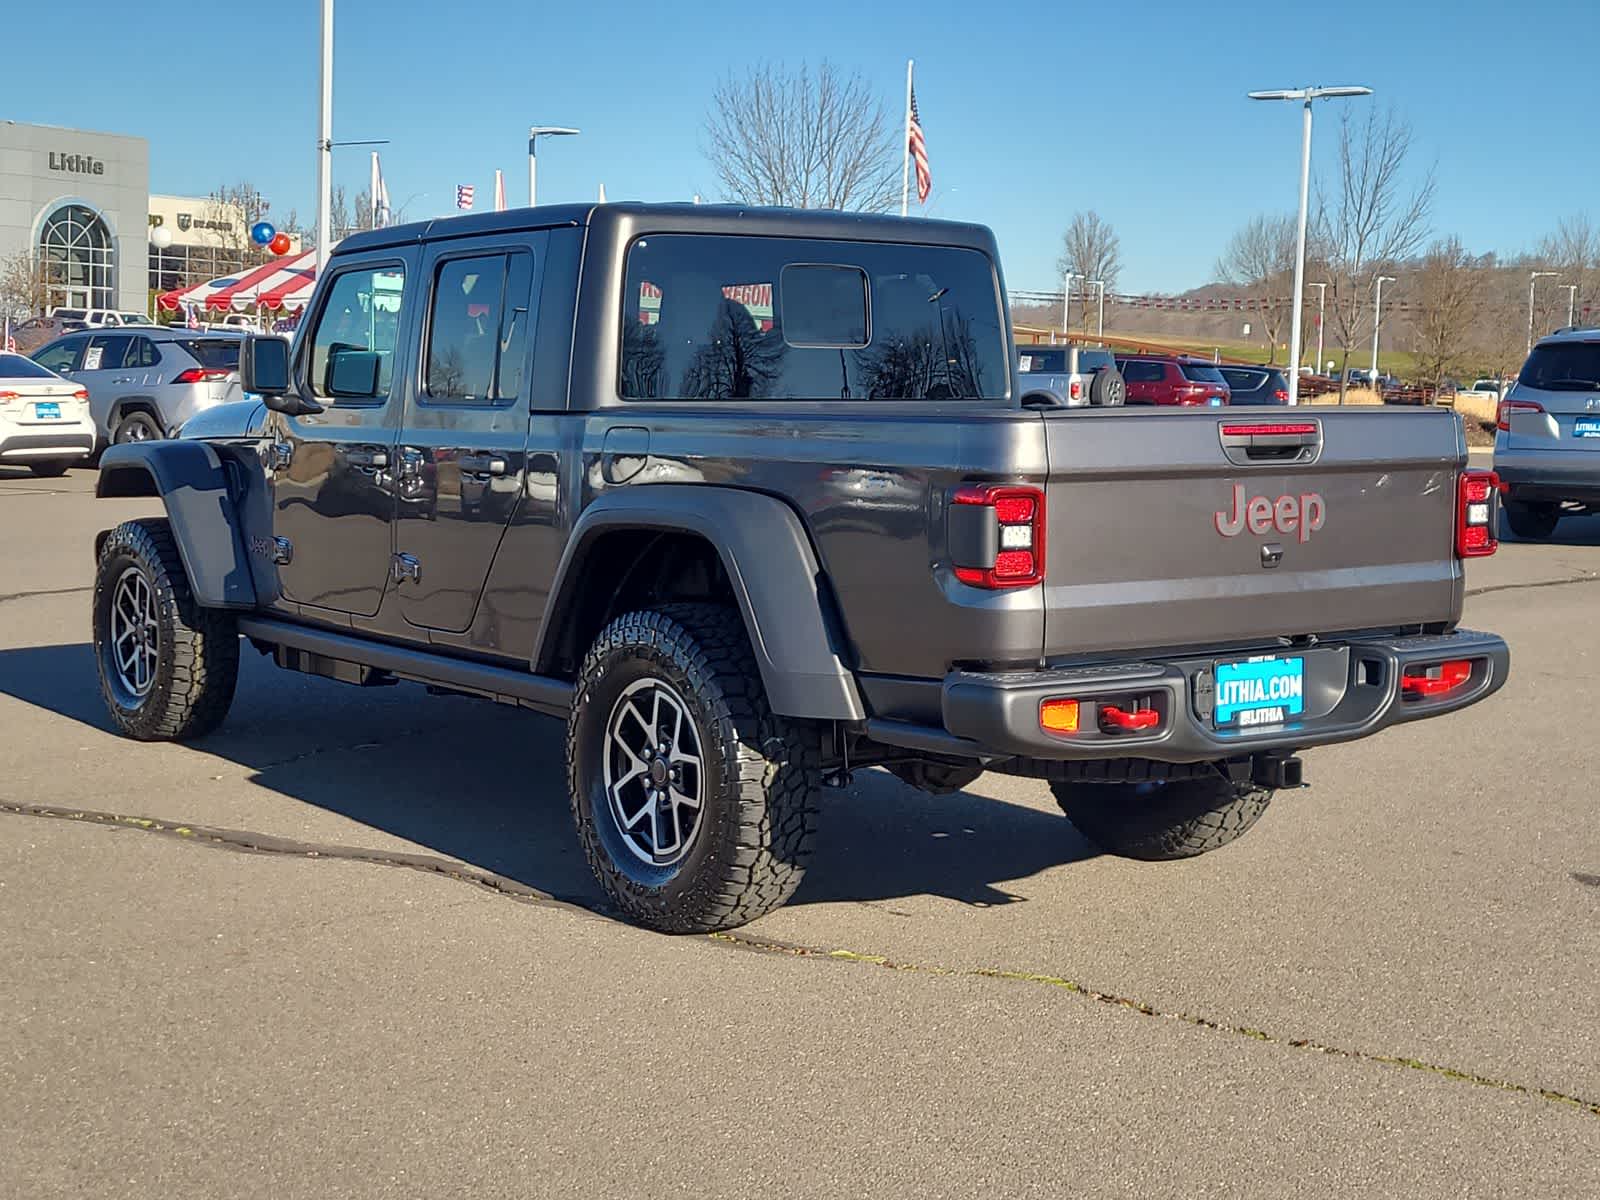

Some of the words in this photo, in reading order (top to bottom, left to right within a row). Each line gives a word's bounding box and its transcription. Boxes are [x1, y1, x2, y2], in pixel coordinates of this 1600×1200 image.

[49, 151, 104, 175] Lithia
[1215, 484, 1326, 544] Jeep
[1216, 673, 1303, 706] LITHIA.COM
